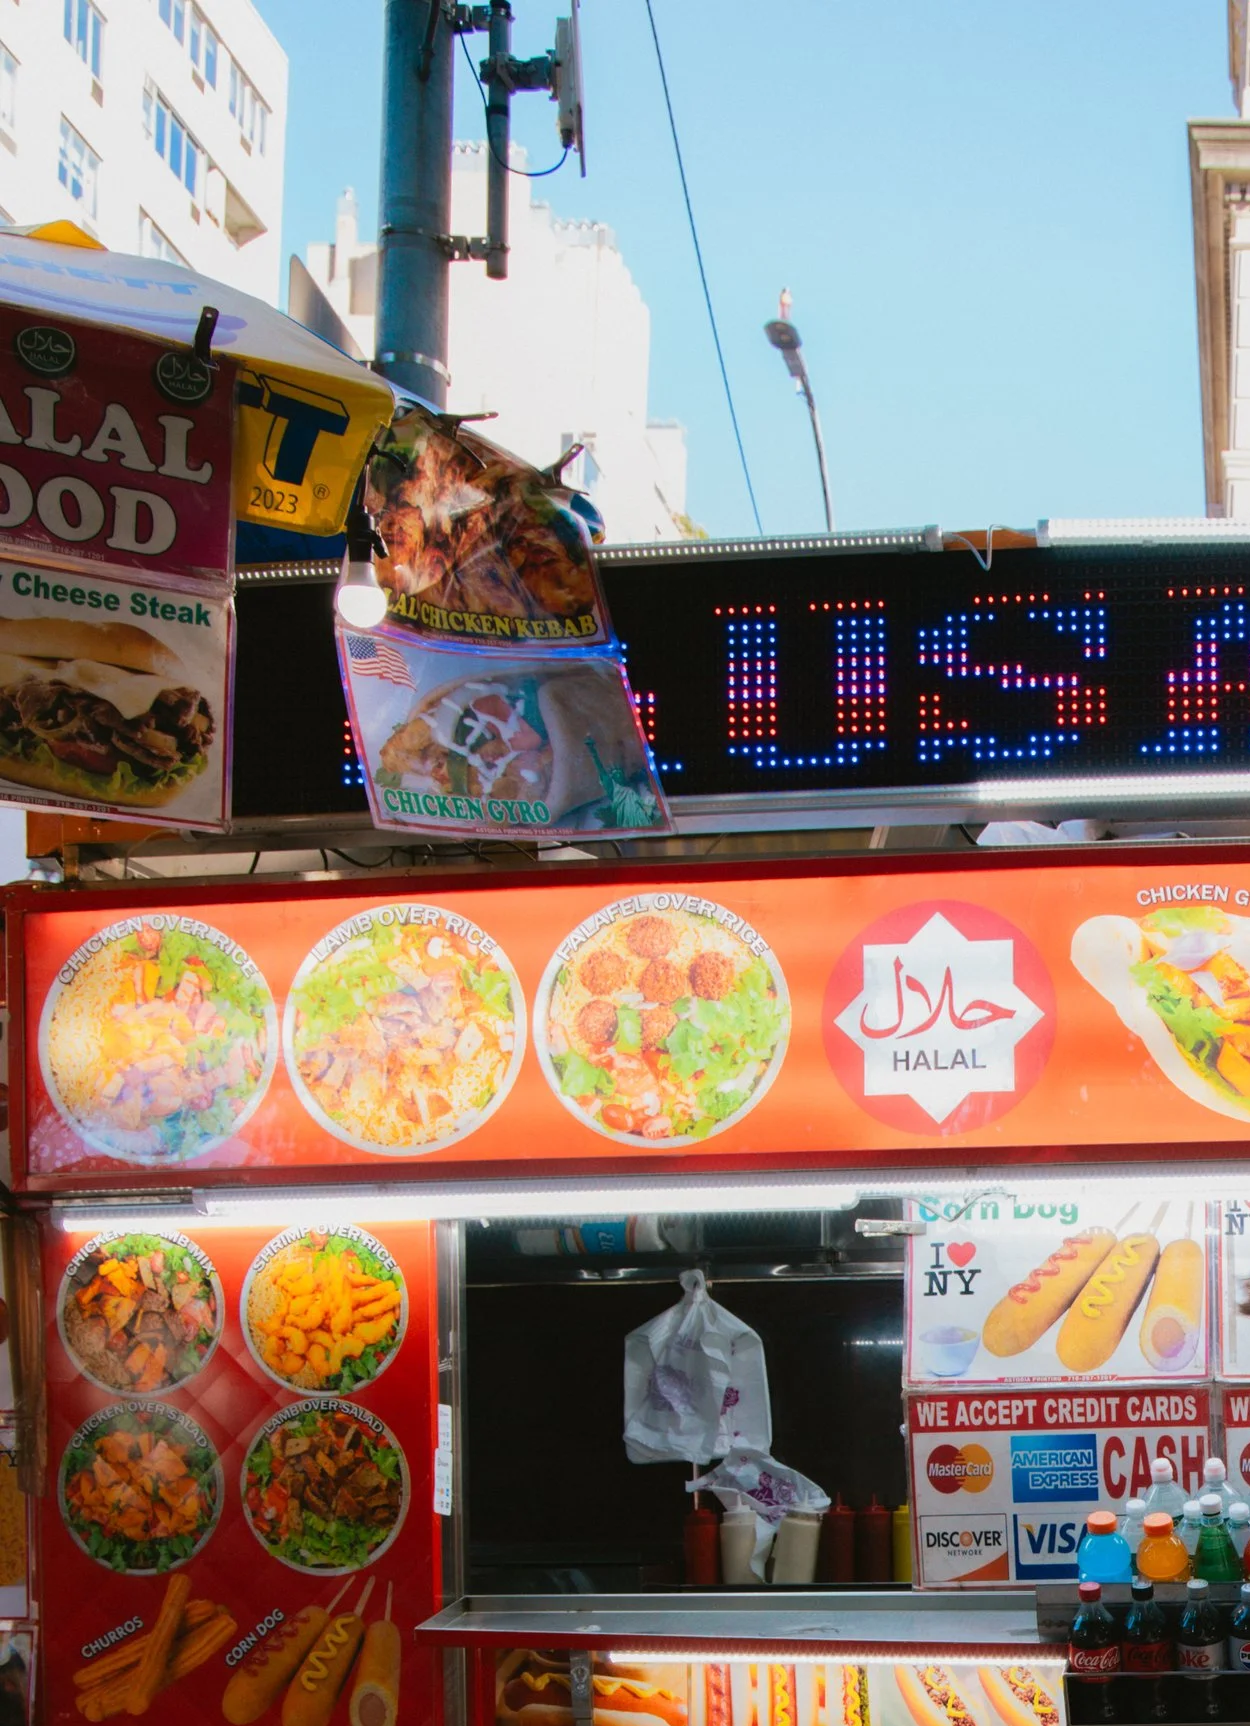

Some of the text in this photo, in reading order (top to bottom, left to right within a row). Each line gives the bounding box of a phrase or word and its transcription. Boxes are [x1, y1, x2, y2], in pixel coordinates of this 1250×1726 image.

[30, 351, 61, 364] HALAL
[168, 381, 199, 393] HALAL
[250, 487, 299, 513] 2023
[12, 572, 211, 627] Cheese Steak
[421, 604, 510, 636] CHICKEN
[515, 614, 598, 639] KEBAB
[383, 788, 550, 823] CHICKEN GYRO
[1136, 884, 1229, 906] CHICKEN
[312, 907, 497, 961] LAMB OVER RICE
[558, 893, 769, 960] FALAFEL OVER RICE
[59, 914, 259, 984] CHICKEN OVER RICE
[860, 956, 1016, 1039] حلال
[892, 1048, 986, 1072] HALAL
[190, 1247, 217, 1276] MIX
[253, 1222, 397, 1272] SHRIMP OVER RICE
[930, 1242, 946, 1269] I
[923, 1269, 982, 1296] NY
[71, 1401, 209, 1449] CHICKEN OVER SALAD
[263, 1399, 384, 1435] LAMB OVER SALAD
[917, 1395, 1197, 1427] WE ACCEPT CREDIT CARDS
[928, 1459, 994, 1478] MasterCard
[1012, 1450, 1093, 1467] AMERICAN
[1102, 1434, 1204, 1499] CASH
[1030, 1471, 1099, 1488] EXPRESS
[926, 1530, 1003, 1548] DISCOVER
[947, 1549, 982, 1557] NETWORK
[81, 1615, 144, 1659] CHURROS
[225, 1608, 285, 1667] CORN DOG
